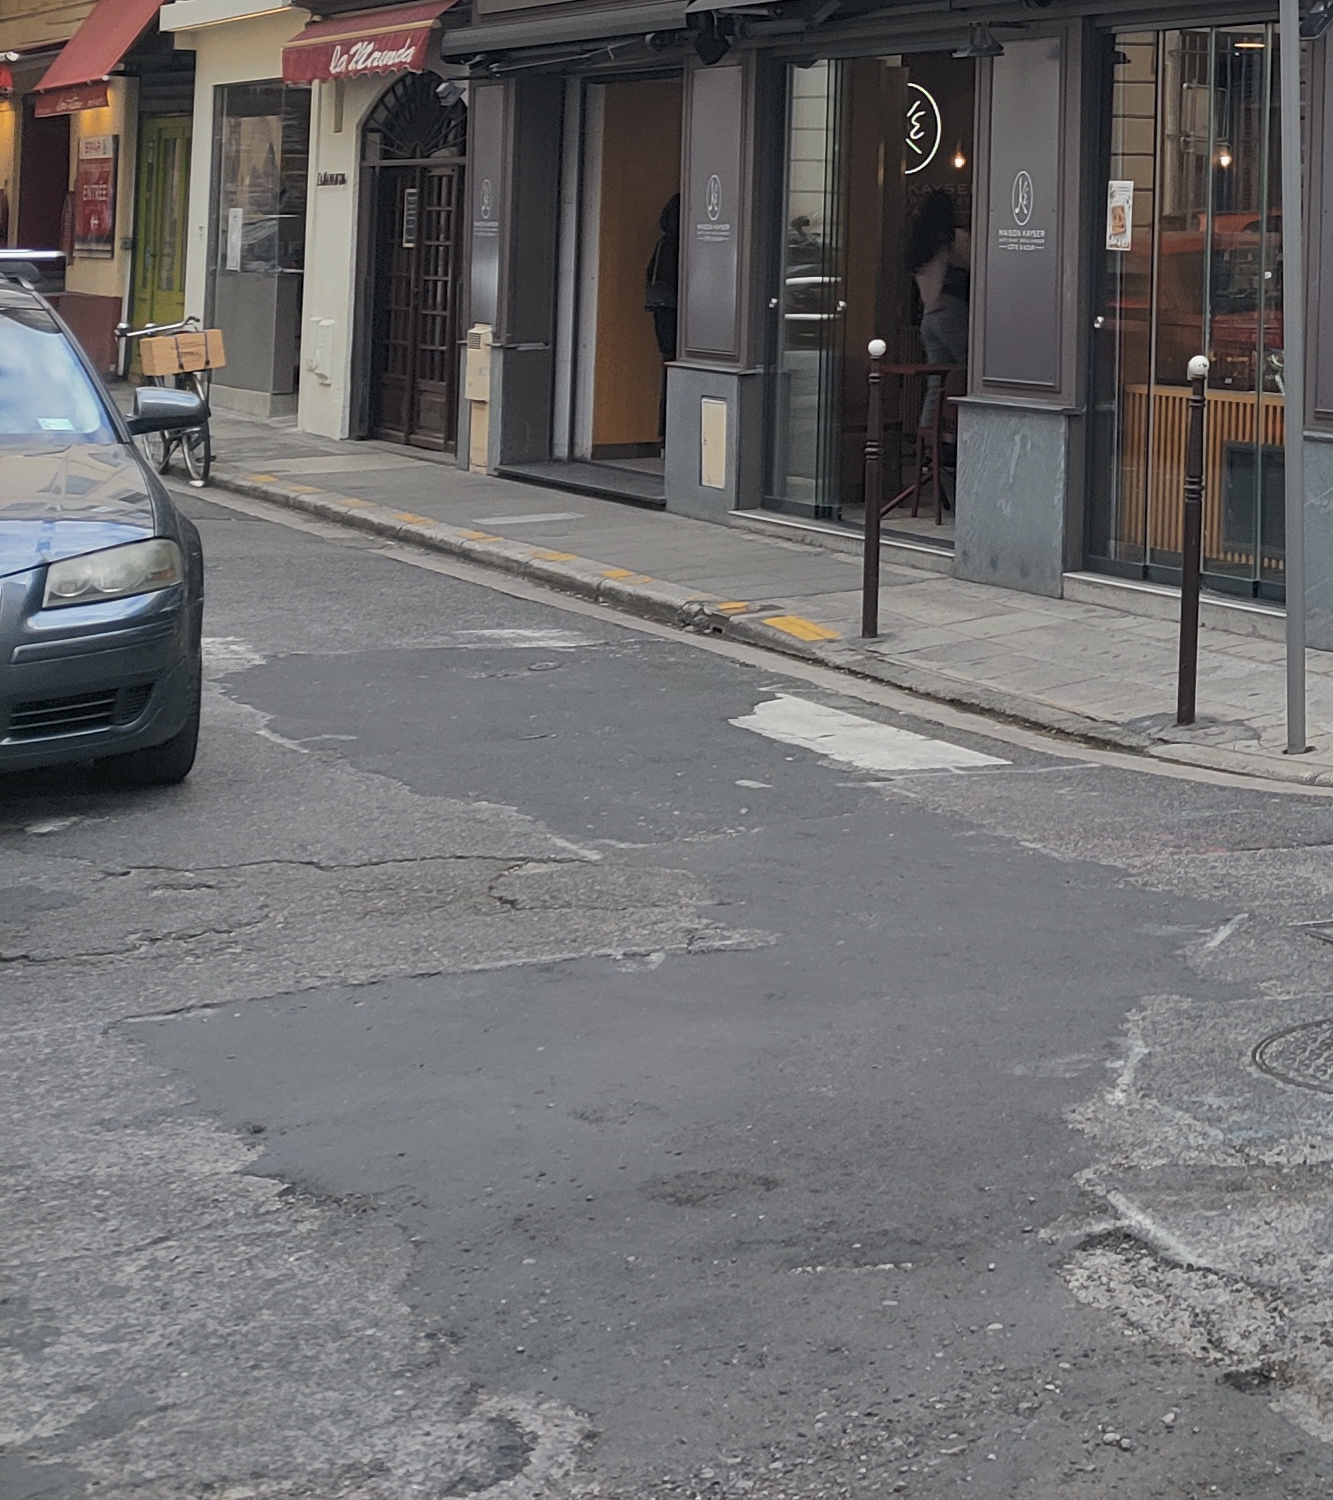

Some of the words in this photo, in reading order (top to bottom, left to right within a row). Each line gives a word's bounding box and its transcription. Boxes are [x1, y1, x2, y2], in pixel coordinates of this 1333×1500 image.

[908, 183, 968, 195] KAYSE
[998, 229, 1021, 238] MAISON
[1022, 229, 1045, 238] KAYSER
